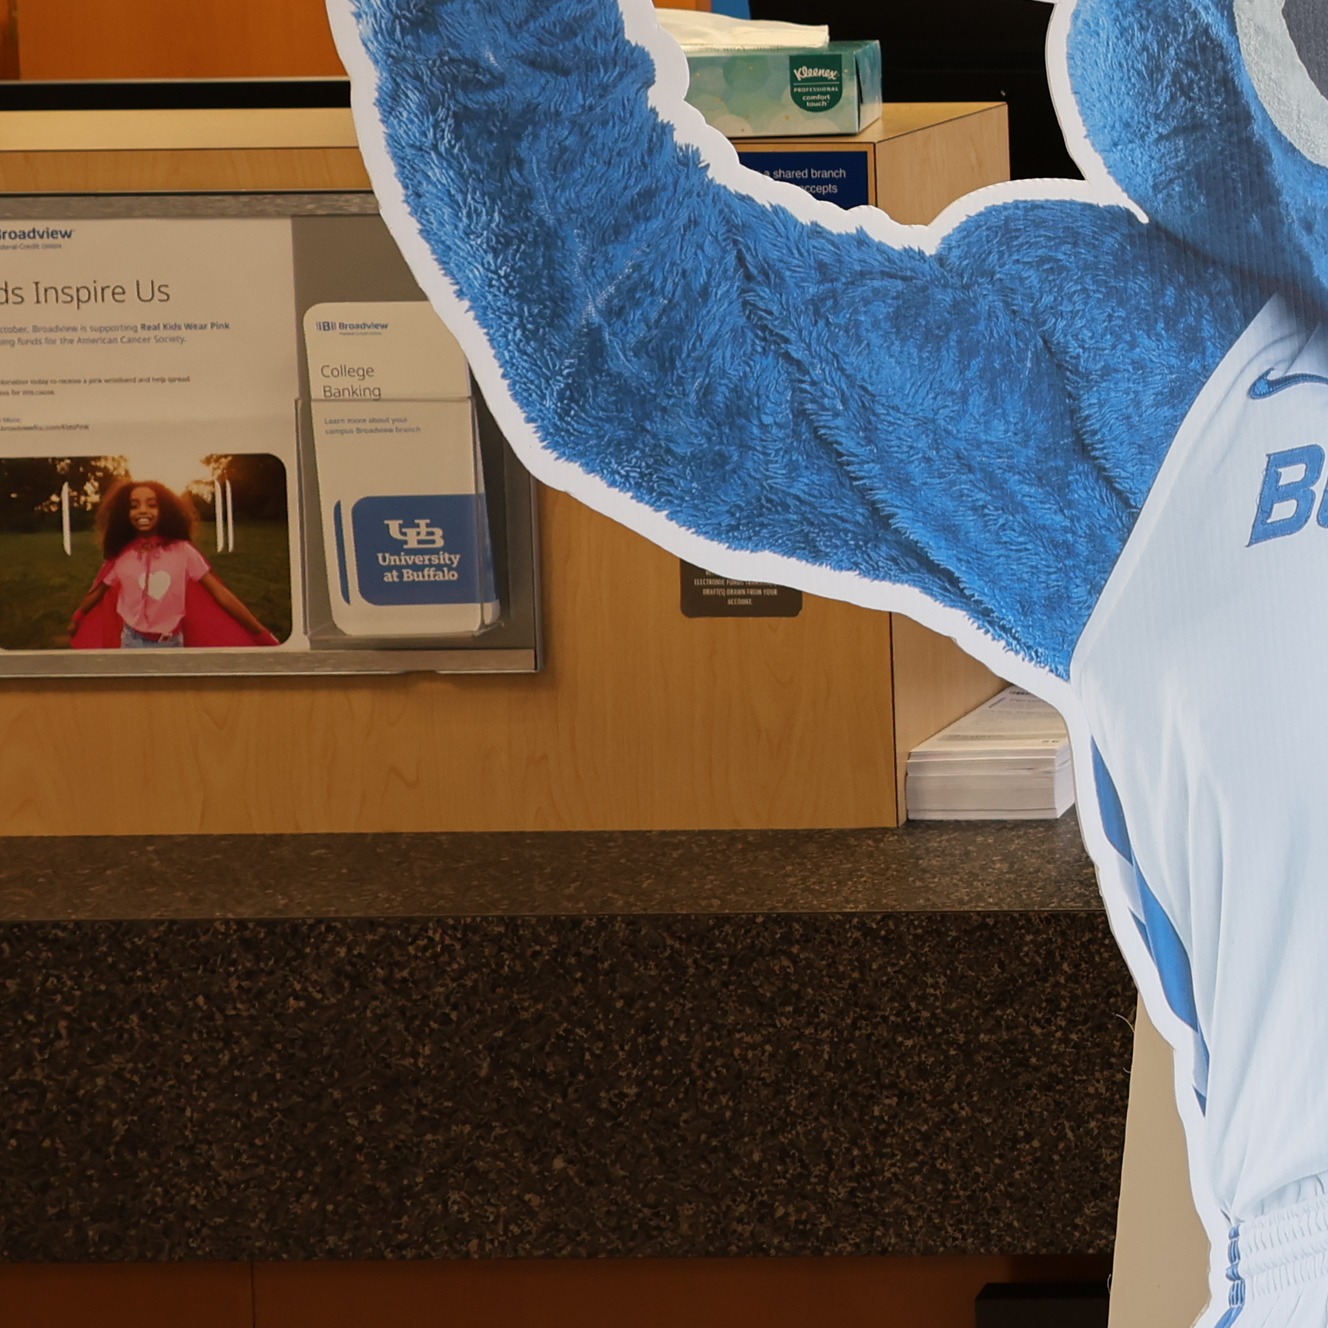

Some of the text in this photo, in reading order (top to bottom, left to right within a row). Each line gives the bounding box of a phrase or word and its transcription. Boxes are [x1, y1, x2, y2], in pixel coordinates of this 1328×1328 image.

[793, 65, 838, 81] Kleenex
[773, 168, 808, 179] shared
[811, 168, 846, 179] branch
[33, 279, 126, 310] Inspire
[135, 279, 171, 303] Us
[32, 325, 79, 334] Broadview
[80, 325, 87, 333] is
[89, 324, 138, 335] supporting
[140, 323, 160, 332] Real
[163, 322, 182, 331] Kids
[183, 322, 207, 331] Wear
[210, 322, 230, 331] Pink
[339, 322, 388, 330] Broadview
[17, 337, 42, 346] funds
[44, 337, 56, 345] for
[59, 337, 74, 345] the
[76, 336, 118, 345] American
[119, 335, 151, 344] Cancer
[153, 335, 186, 345] Society.
[320, 364, 374, 381] College
[323, 384, 381, 401] Banking
[324, 417, 345, 425] Learn
[391, 417, 408, 425] your
[325, 428, 354, 436] campus
[356, 426, 394, 434] Broadview
[376, 551, 461, 568] University
[383, 567, 458, 582] at Buffalo
